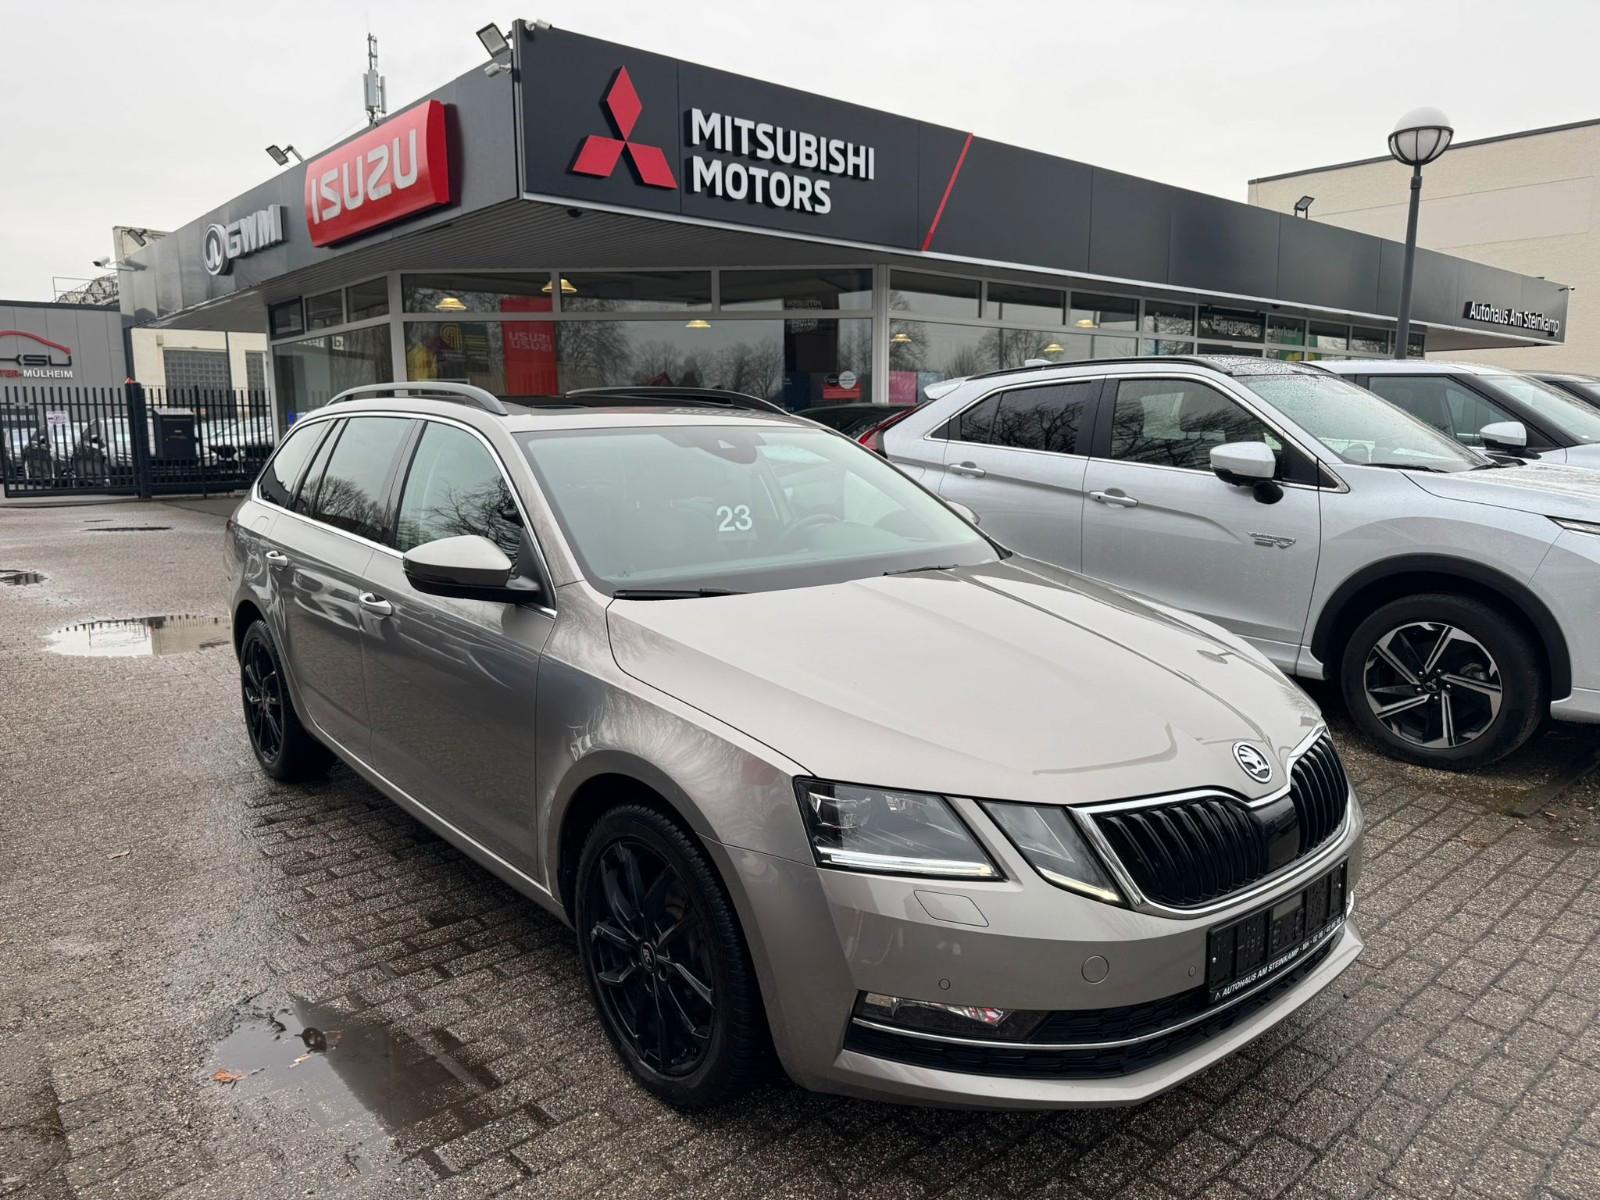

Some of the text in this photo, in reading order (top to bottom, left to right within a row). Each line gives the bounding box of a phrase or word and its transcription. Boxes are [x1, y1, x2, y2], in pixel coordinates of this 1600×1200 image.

[691, 107, 875, 181] MITSUBISHI
[311, 128, 418, 225] ISUZU
[692, 155, 832, 214] MOTORS
[225, 204, 283, 259] GWM
[1471, 303, 1560, 336] Autohaus Am Steinkamp
[716, 505, 753, 532] 23
[1223, 973, 1257, 996] AUTOHAUS
[1257, 966, 1268, 979] AM
